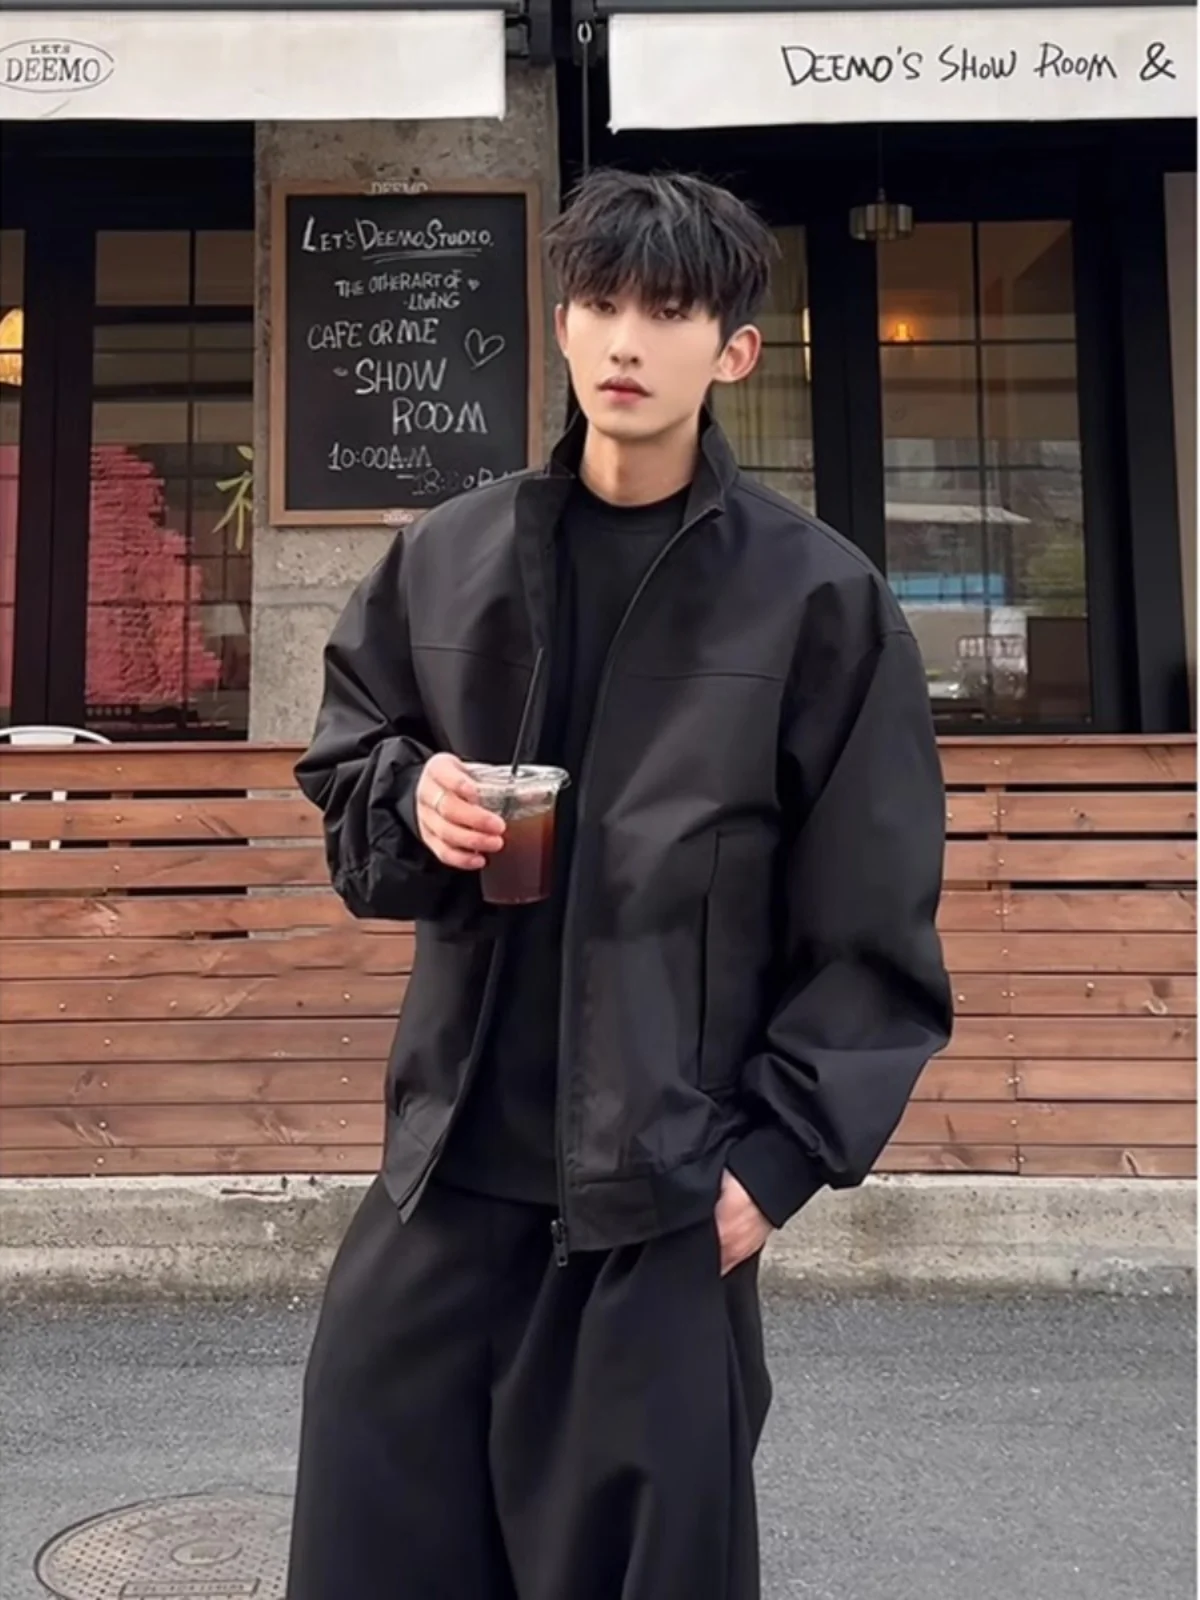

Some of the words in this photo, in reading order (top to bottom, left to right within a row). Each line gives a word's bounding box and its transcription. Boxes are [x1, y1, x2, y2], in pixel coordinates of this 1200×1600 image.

[6, 57, 101, 82] DEEMO
[781, 45, 922, 85] DEEMO'S
[939, 44, 1017, 82] SHOW
[1033, 42, 1118, 81] ROOM
[1139, 42, 1176, 81] &
[355, 218, 425, 250] DEEMO
[334, 279, 364, 298] THE
[443, 268, 462, 289] OF
[307, 320, 362, 350] CAFE
[368, 319, 394, 345] OR
[396, 317, 439, 344] ME
[355, 357, 448, 395] SHOW
[392, 397, 488, 435] ROOM
